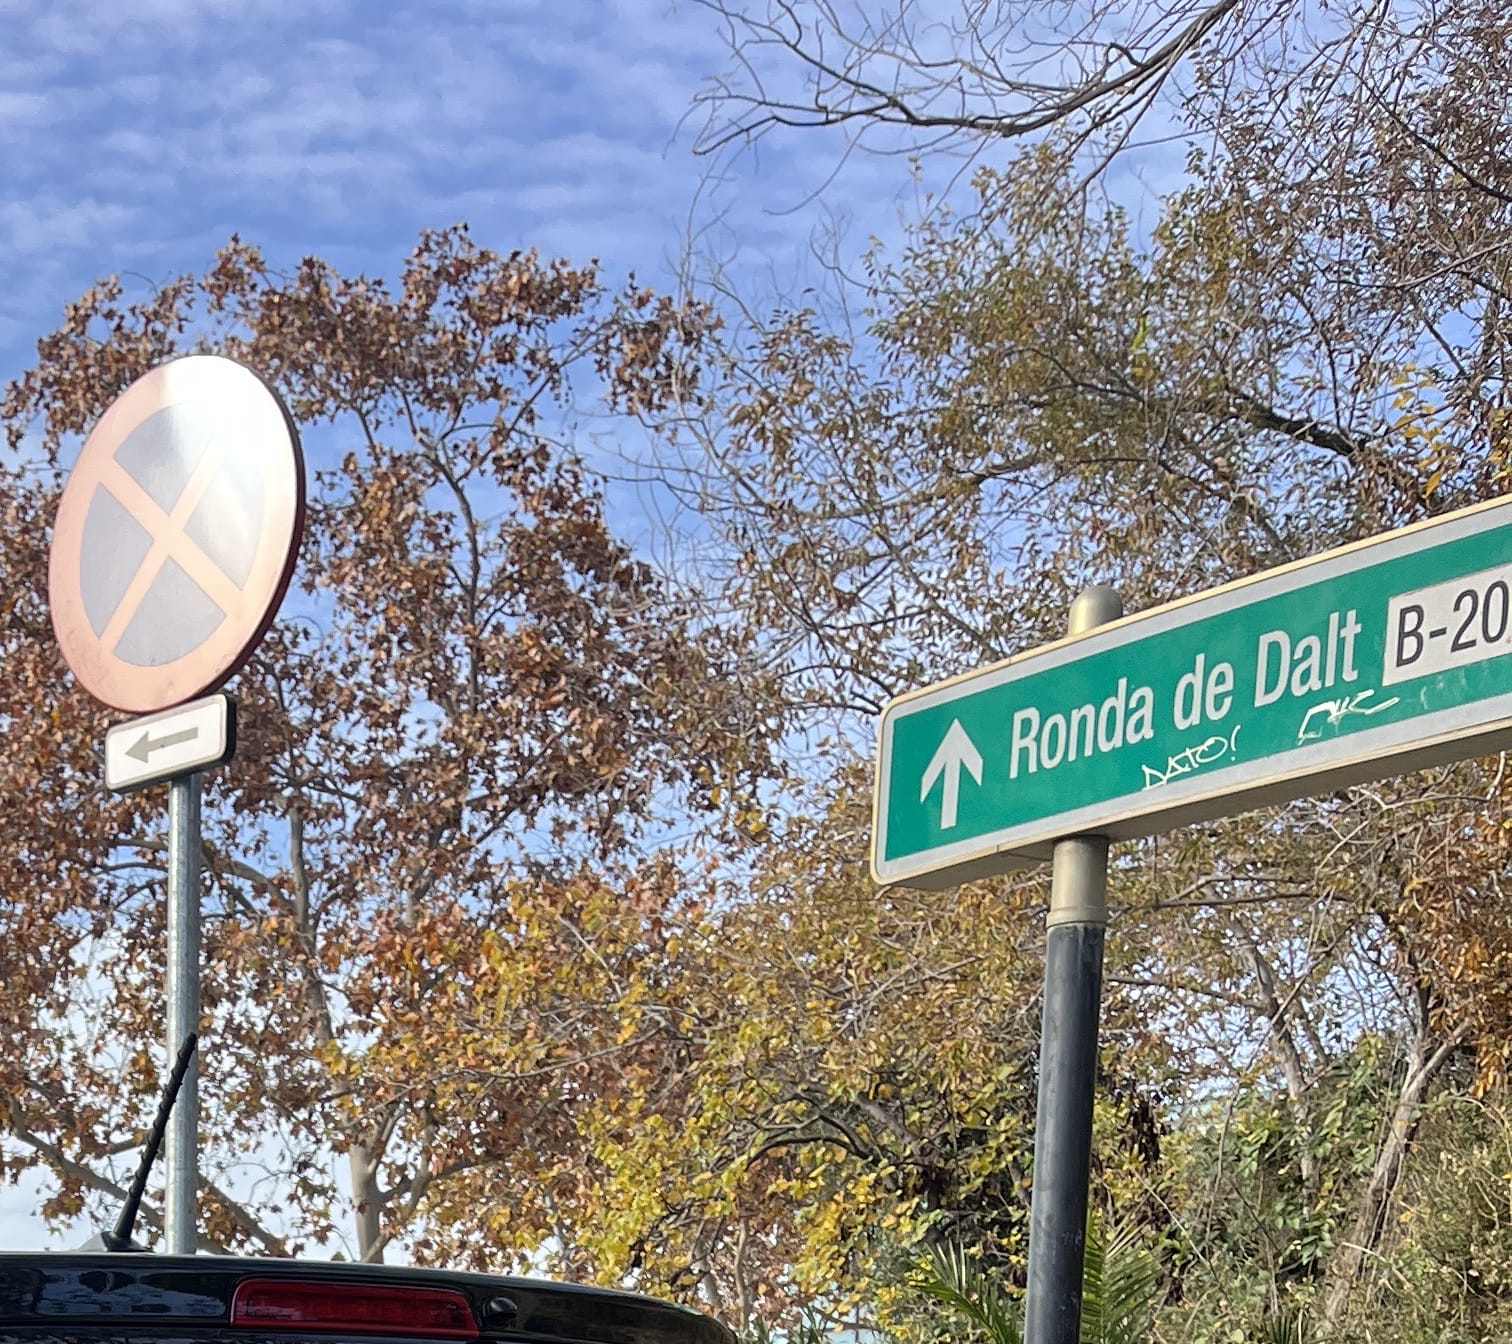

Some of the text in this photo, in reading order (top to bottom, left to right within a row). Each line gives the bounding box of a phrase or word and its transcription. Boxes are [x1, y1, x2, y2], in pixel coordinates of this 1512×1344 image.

[1010, 677, 1154, 779] Ronda
[1174, 653, 1235, 731] de
[1254, 609, 1363, 708] Dalt
[1396, 580, 1511, 668] B-20
